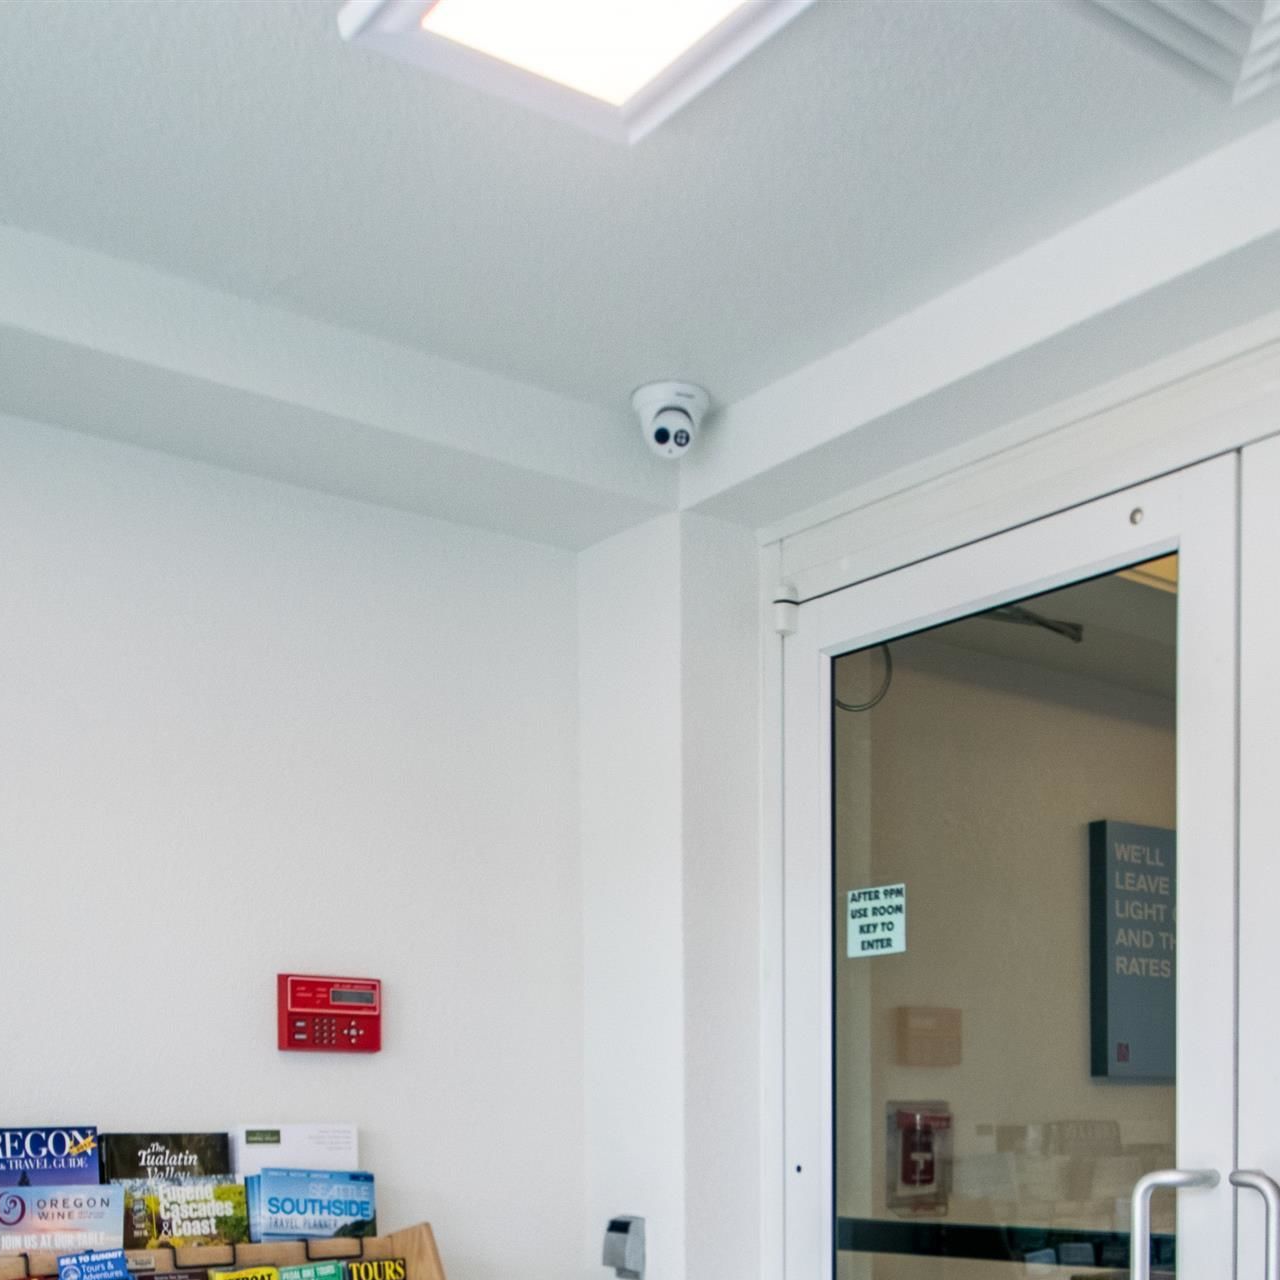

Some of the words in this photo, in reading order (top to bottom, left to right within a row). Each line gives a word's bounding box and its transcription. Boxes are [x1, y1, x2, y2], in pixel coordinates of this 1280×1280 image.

[1115, 844, 1164, 866] WE'LL
[1115, 872, 1169, 895] LEAVE
[850, 890, 880, 903] AFTER
[851, 908, 868, 919] USE
[872, 904, 903, 916] ROOM
[1115, 901, 1167, 922] LIGHT
[859, 923, 878, 934] KEY
[881, 921, 894, 932] TO
[861, 938, 892, 951] ENTER
[1116, 929, 1155, 949] AND
[1116, 957, 1170, 978] RATES
[150, 1142, 165, 1153] The
[9, 1158, 51, 1170] TRAVEL
[52, 1157, 88, 1169] GUIDE
[138, 1149, 198, 1167] Tualatin
[37, 1198, 110, 1209] OREGON
[160, 1200, 234, 1219] Cascades
[268, 1197, 370, 1218] SOUTHSIDE
[38, 1211, 76, 1220] WINE
[162, 1221, 172, 1236] &
[172, 1218, 217, 1236] Coast
[83, 1270, 123, 1280] Adventures
